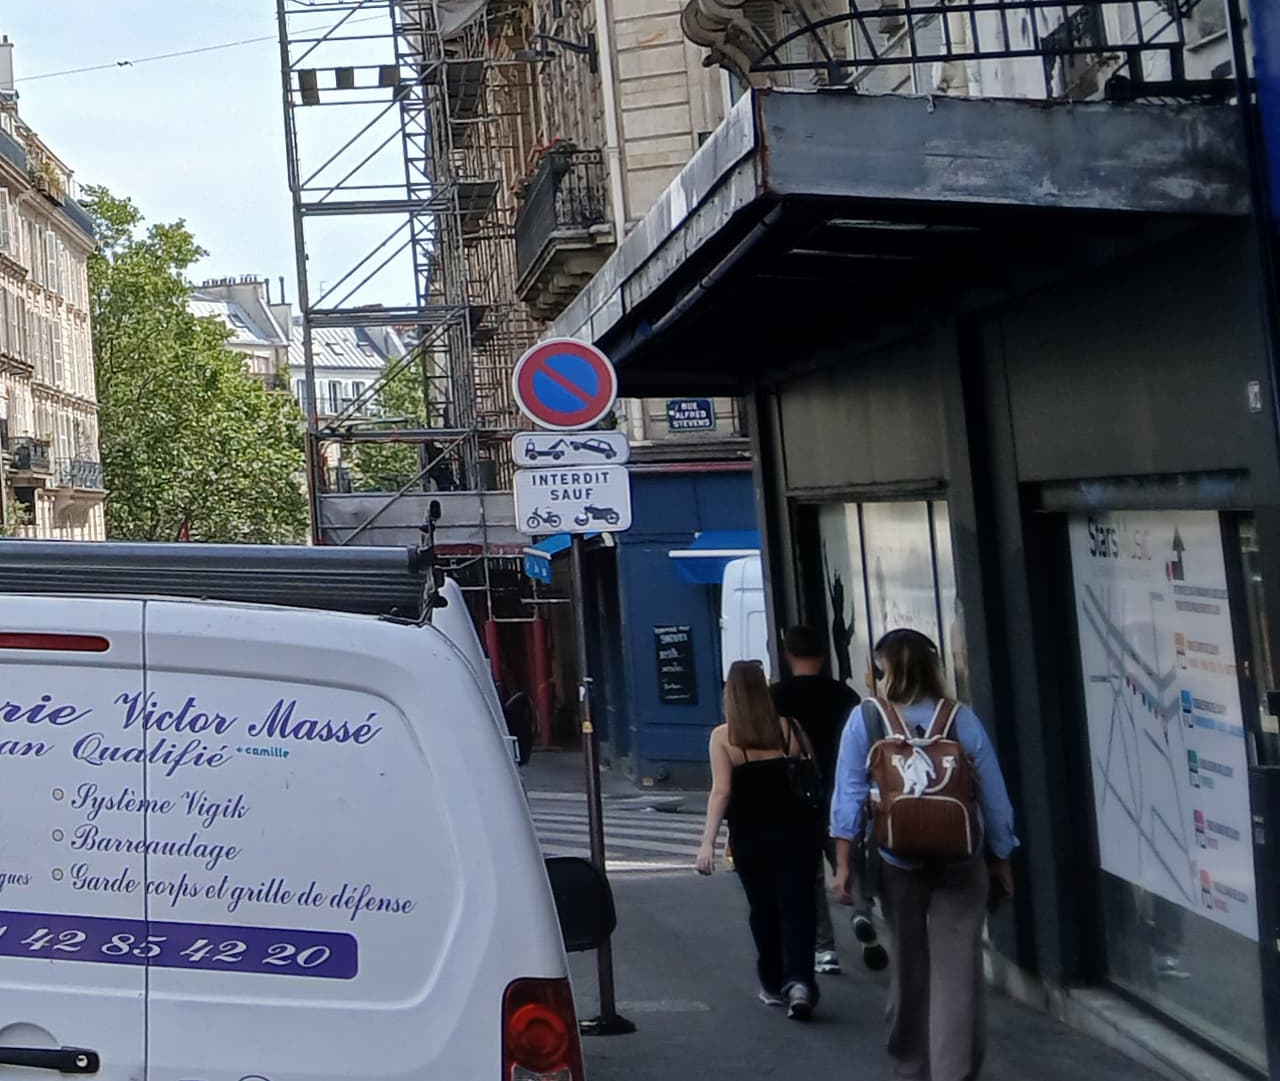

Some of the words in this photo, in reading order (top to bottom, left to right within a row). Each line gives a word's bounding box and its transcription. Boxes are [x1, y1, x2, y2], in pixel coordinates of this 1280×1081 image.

[672, 419, 710, 428] STEVENS
[675, 410, 707, 419] ALFRED
[681, 402, 698, 410] RUE
[532, 472, 609, 486] INTERDIT
[550, 488, 593, 501] SAUF
[113, 691, 239, 735] Victor
[247, 698, 383, 745] Massé
[72, 732, 235, 777] Qualifié
[71, 783, 176, 822] Système
[180, 790, 251, 829] Vigik
[70, 826, 243, 871] Barreaudage
[70, 863, 140, 894] Garde
[145, 873, 200, 908] corps
[204, 875, 230, 900] et
[227, 877, 297, 913] grille
[297, 881, 327, 908] de
[329, 883, 417, 921] défense
[21, 928, 87, 952] 42
[101, 933, 167, 958] 85
[180, 938, 248, 963] 42
[261, 943, 332, 968] 20
